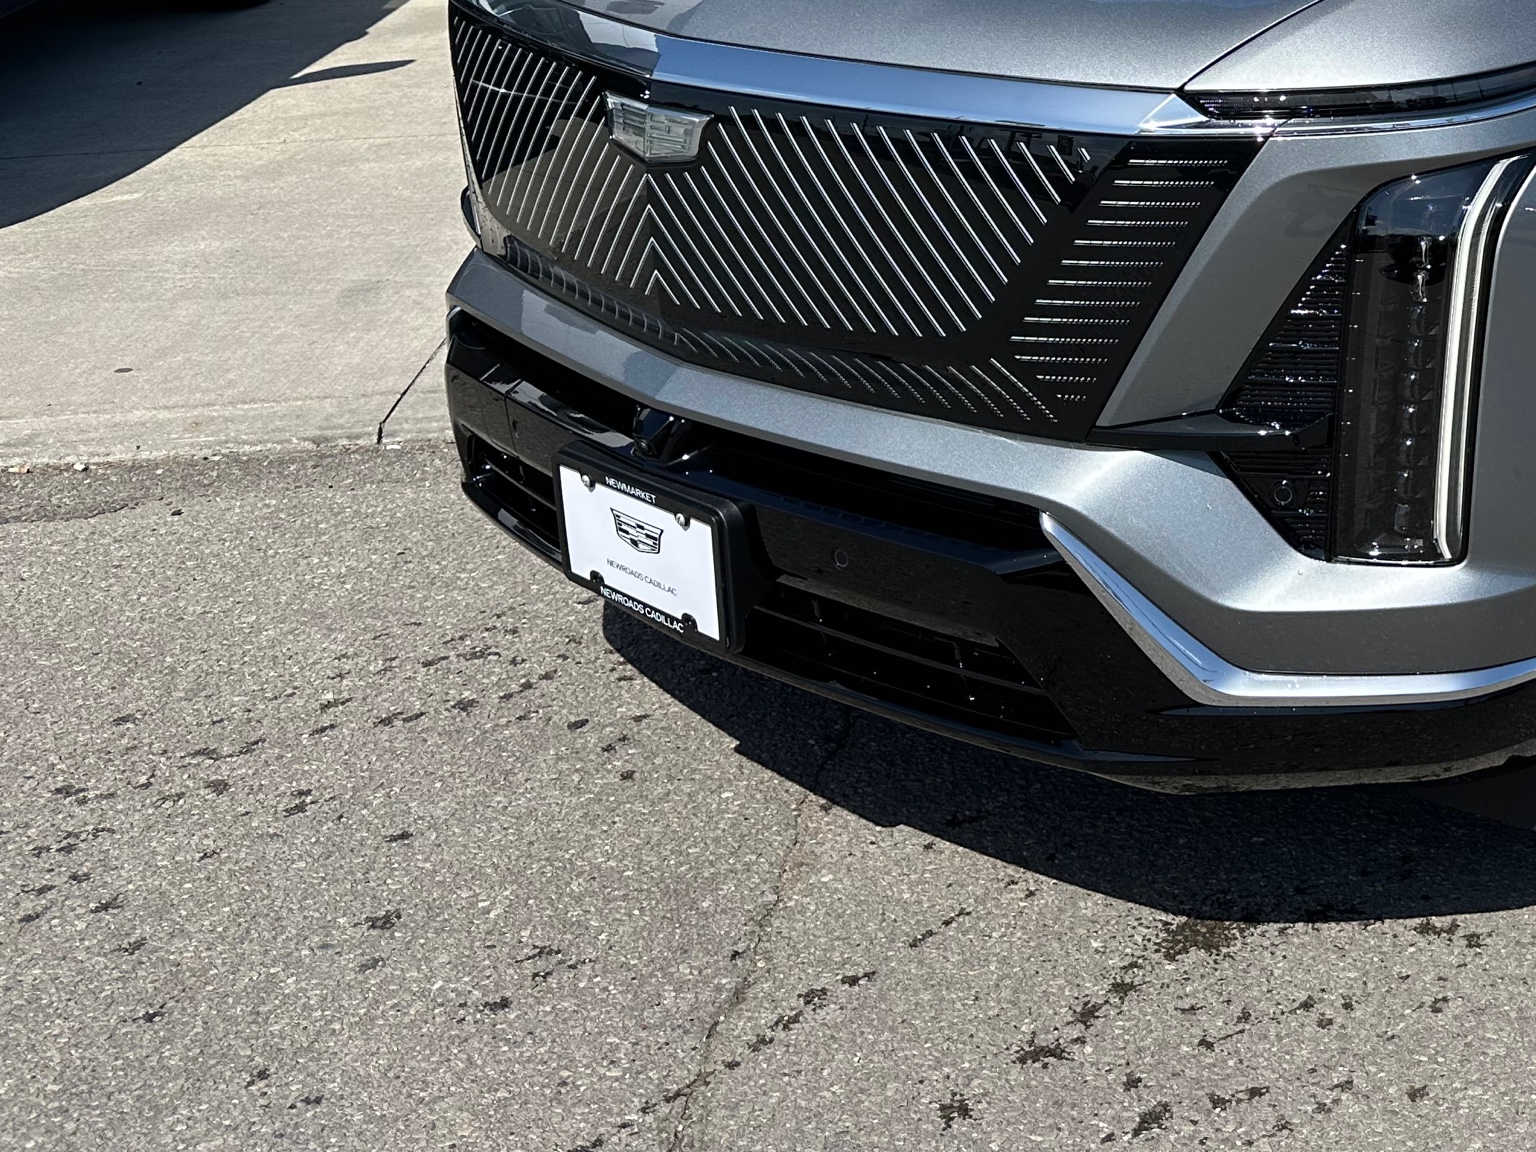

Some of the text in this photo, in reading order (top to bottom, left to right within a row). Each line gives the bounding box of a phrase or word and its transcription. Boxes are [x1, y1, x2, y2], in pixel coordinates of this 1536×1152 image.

[605, 475, 656, 504] NEWMARKET
[607, 558, 678, 597] NEWROADS CADILLAC
[600, 585, 685, 633] NEWROADS CADILLAC
